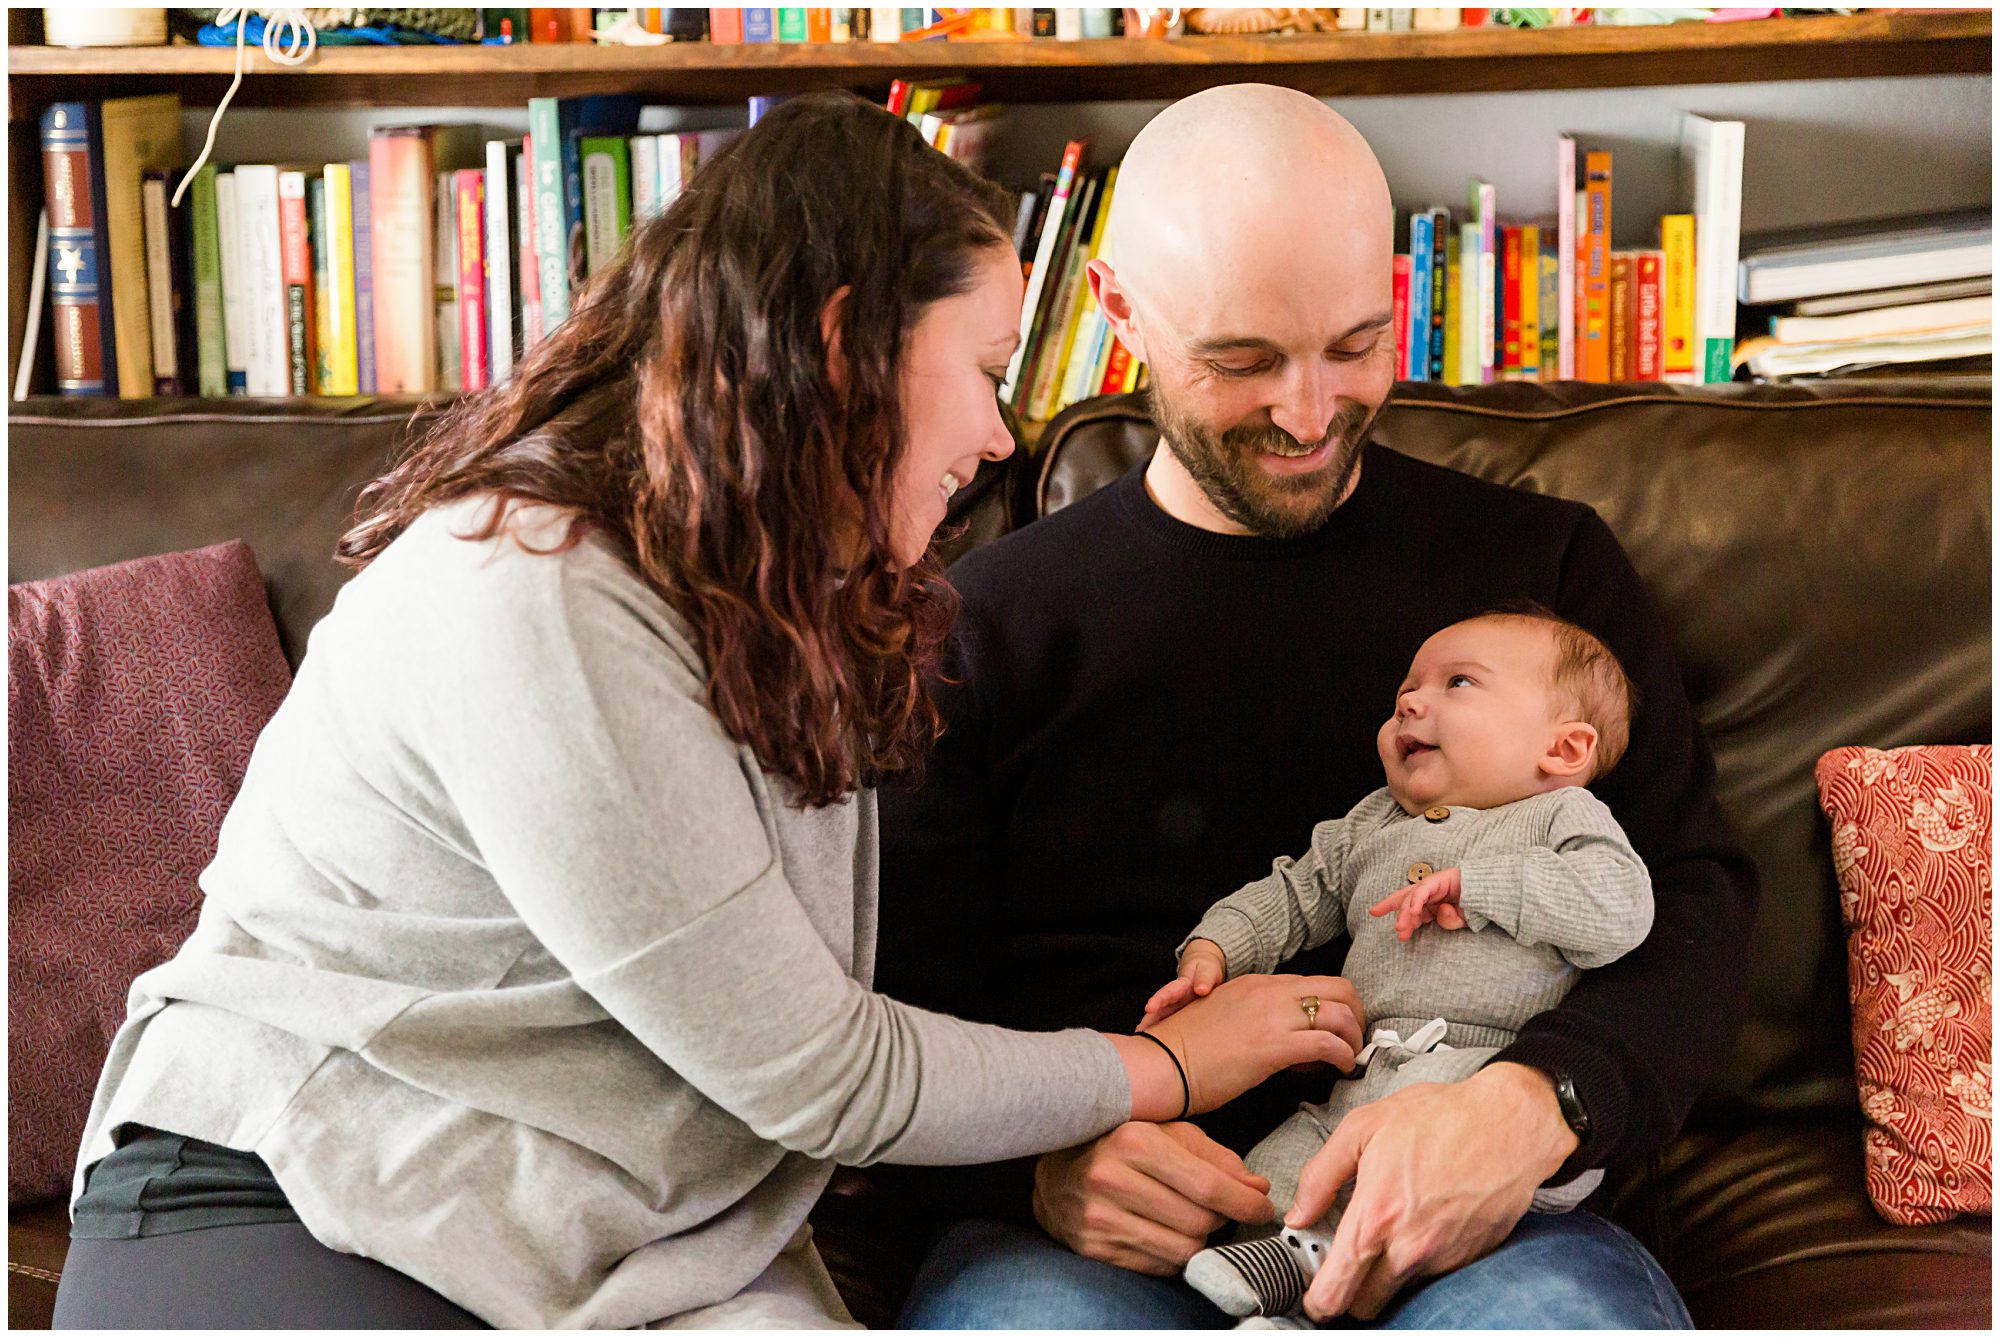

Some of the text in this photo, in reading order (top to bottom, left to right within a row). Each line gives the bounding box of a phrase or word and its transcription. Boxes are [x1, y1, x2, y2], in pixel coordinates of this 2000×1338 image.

[1639, 283, 1658, 375] Little Red Barn
